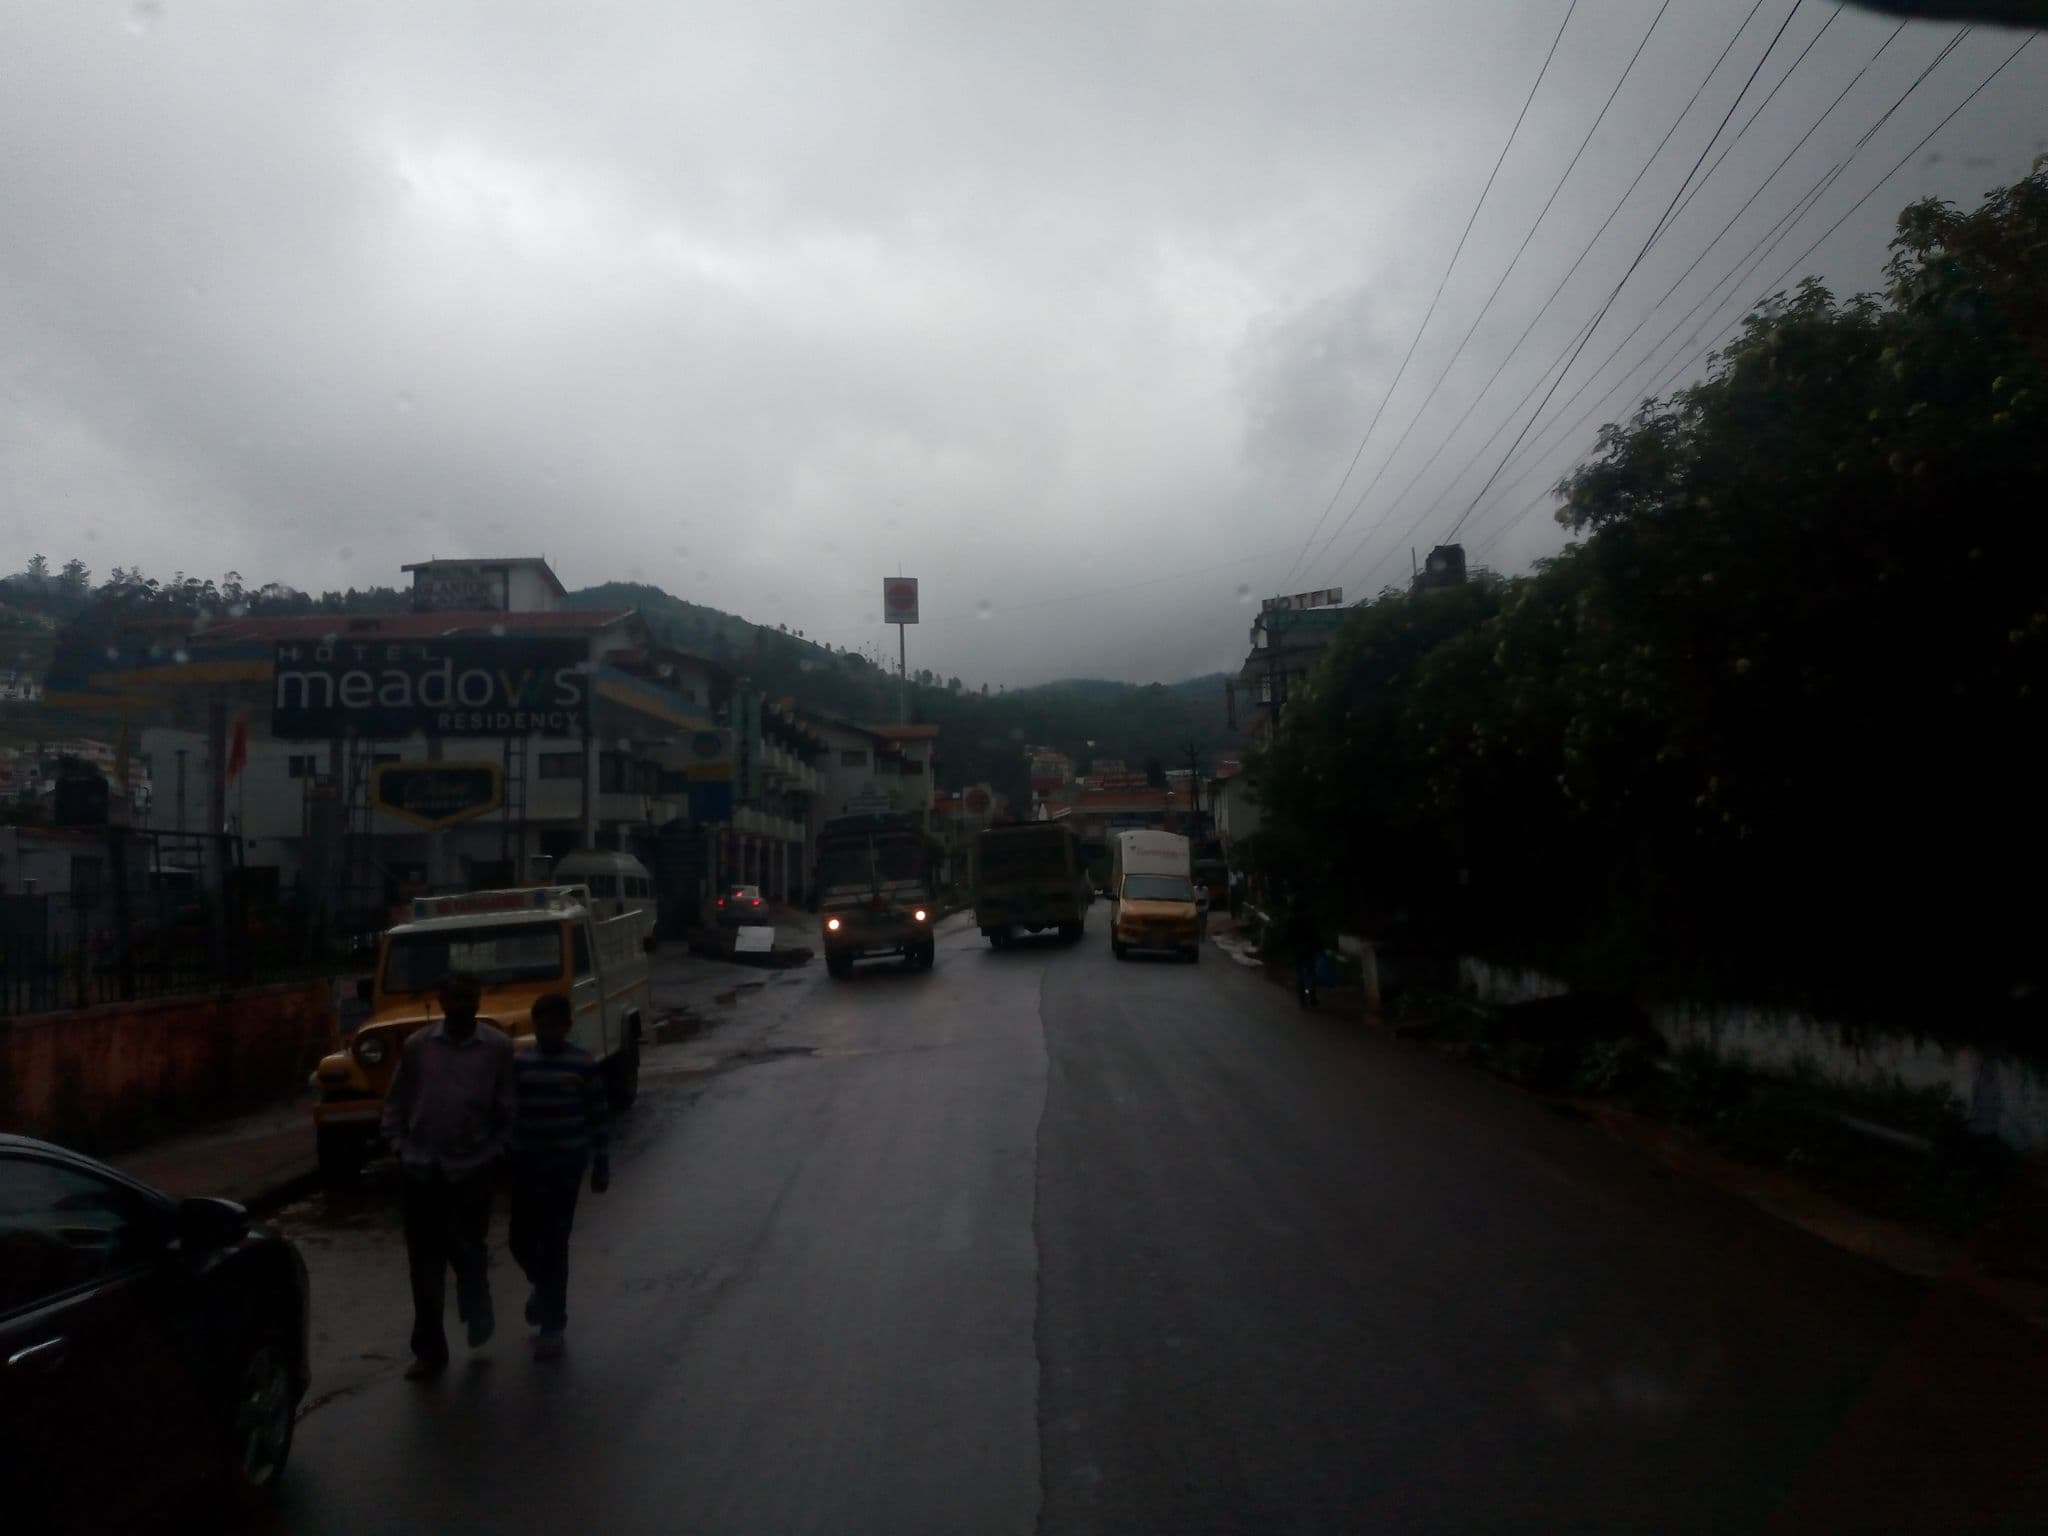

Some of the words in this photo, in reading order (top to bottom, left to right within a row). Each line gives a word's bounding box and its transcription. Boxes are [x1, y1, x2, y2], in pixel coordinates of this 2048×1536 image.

[277, 647, 445, 663] HOTEL
[276, 657, 582, 709] meadows
[437, 711, 580, 730] RESIDENCY
